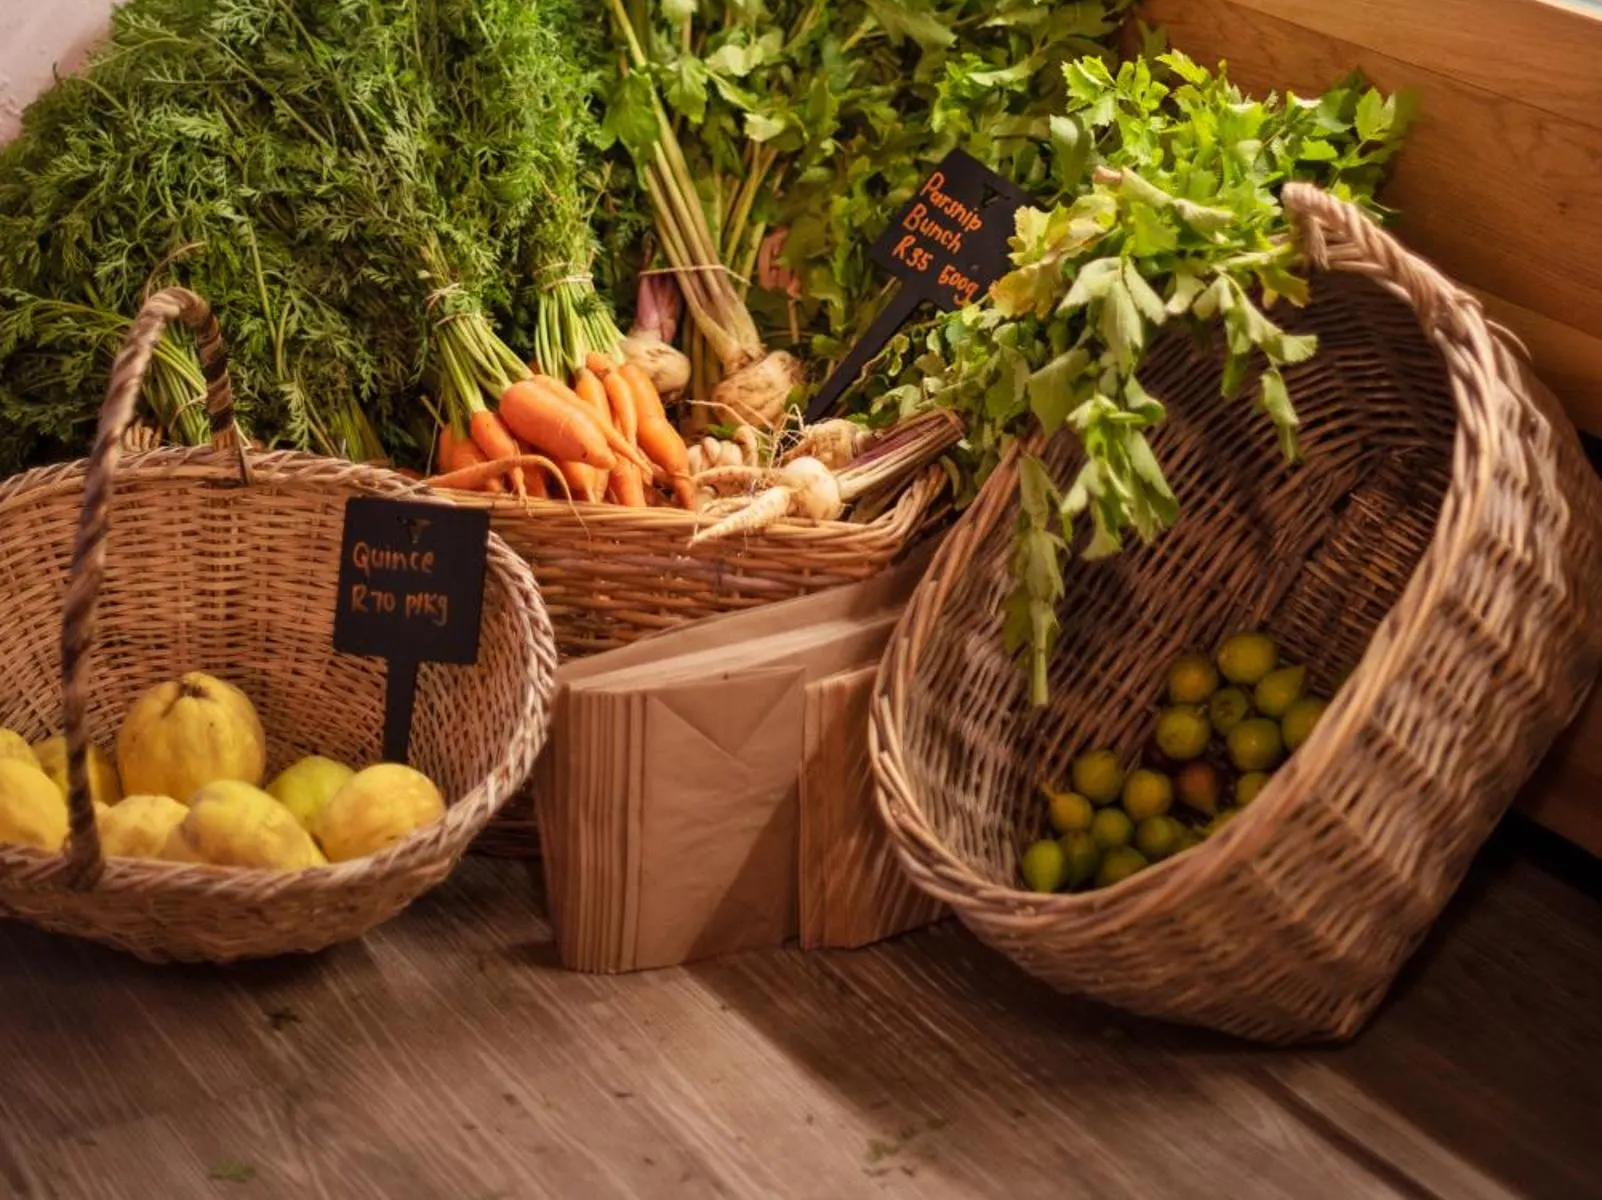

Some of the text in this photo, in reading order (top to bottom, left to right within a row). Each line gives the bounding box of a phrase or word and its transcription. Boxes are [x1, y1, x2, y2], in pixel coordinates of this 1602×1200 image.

[920, 172, 982, 231] Parsnip
[903, 203, 961, 253] Bunch
[893, 235, 933, 271] R35
[353, 542, 434, 577] Quince
[353, 585, 396, 613] R70
